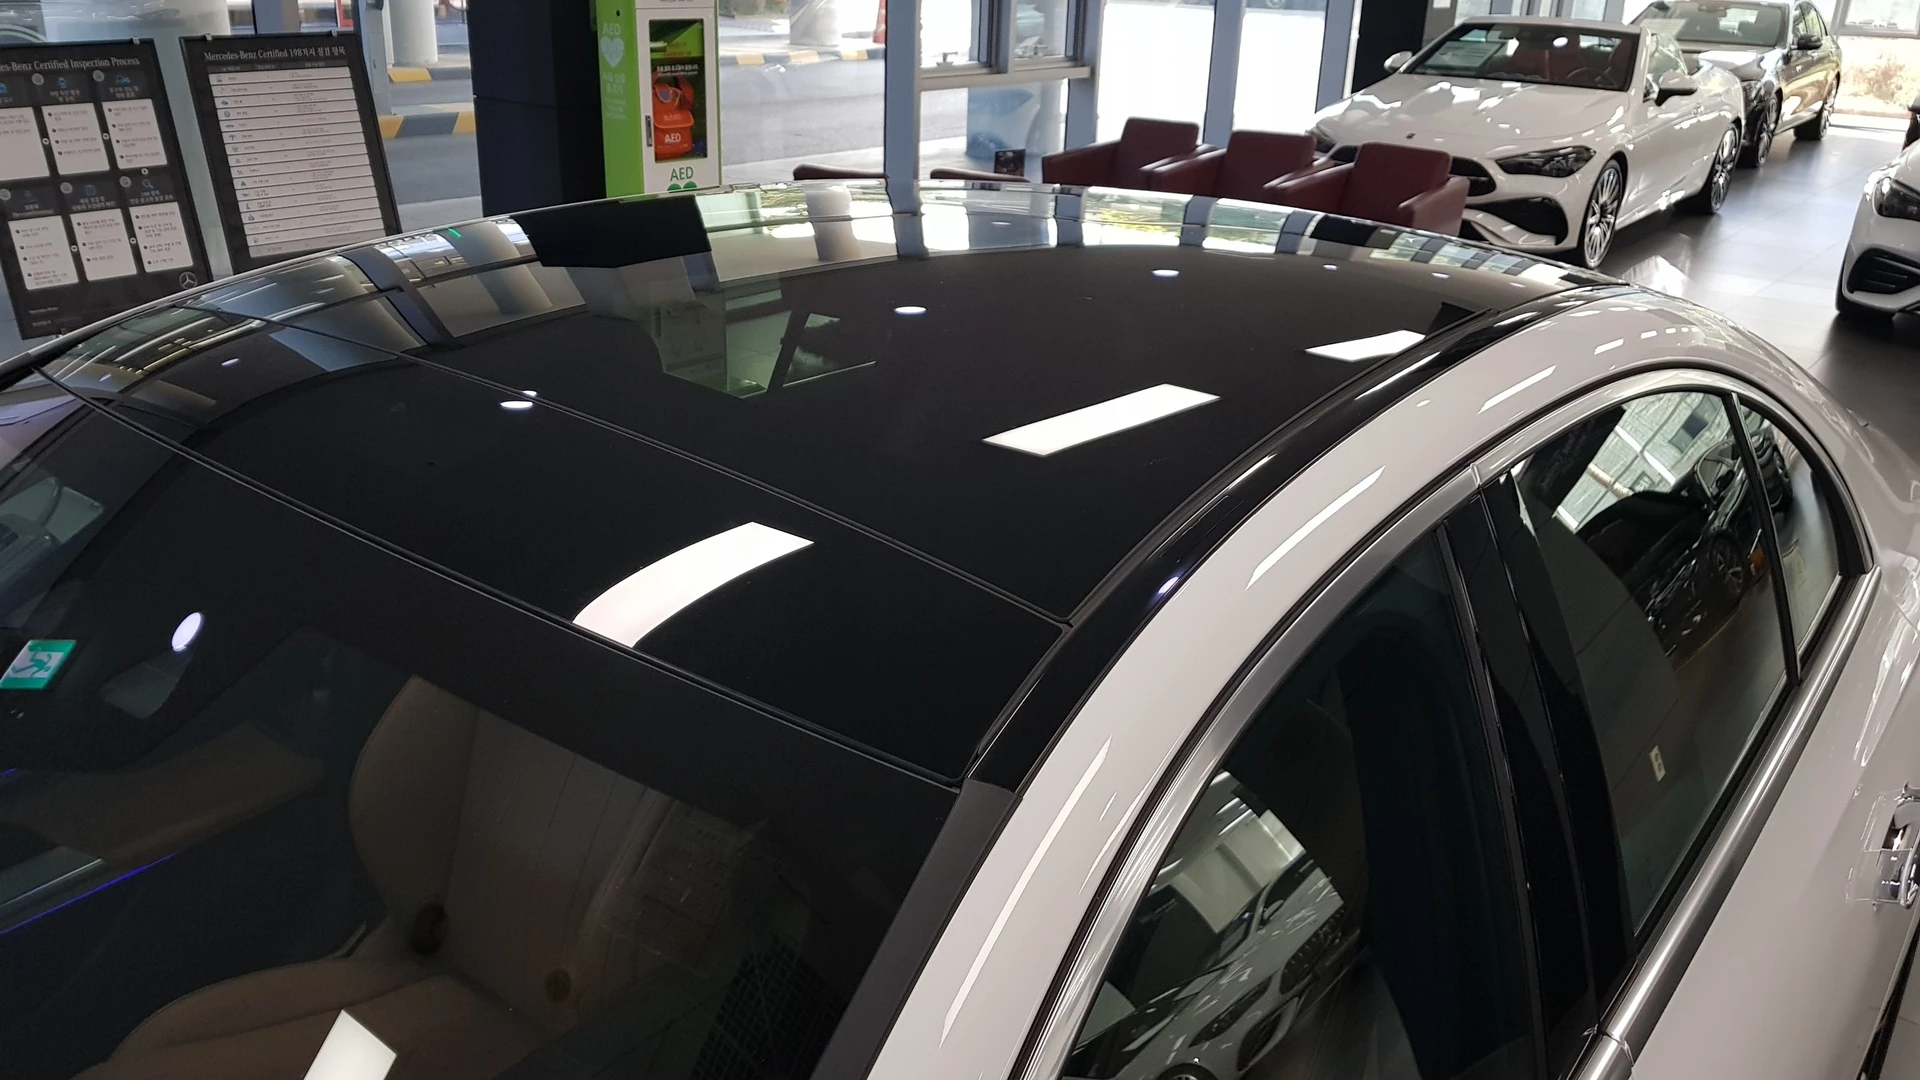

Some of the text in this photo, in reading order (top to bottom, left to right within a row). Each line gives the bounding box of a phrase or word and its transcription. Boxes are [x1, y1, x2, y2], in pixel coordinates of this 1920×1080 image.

[603, 23, 621, 35] AED
[204, 50, 257, 61] Mercedes-Benz
[258, 49, 288, 58] Certified
[34, 60, 69, 70] Certified
[71, 58, 110, 70] Inspection
[111, 57, 140, 66] Process
[665, 133, 681, 143] AED
[670, 166, 694, 181] AED
